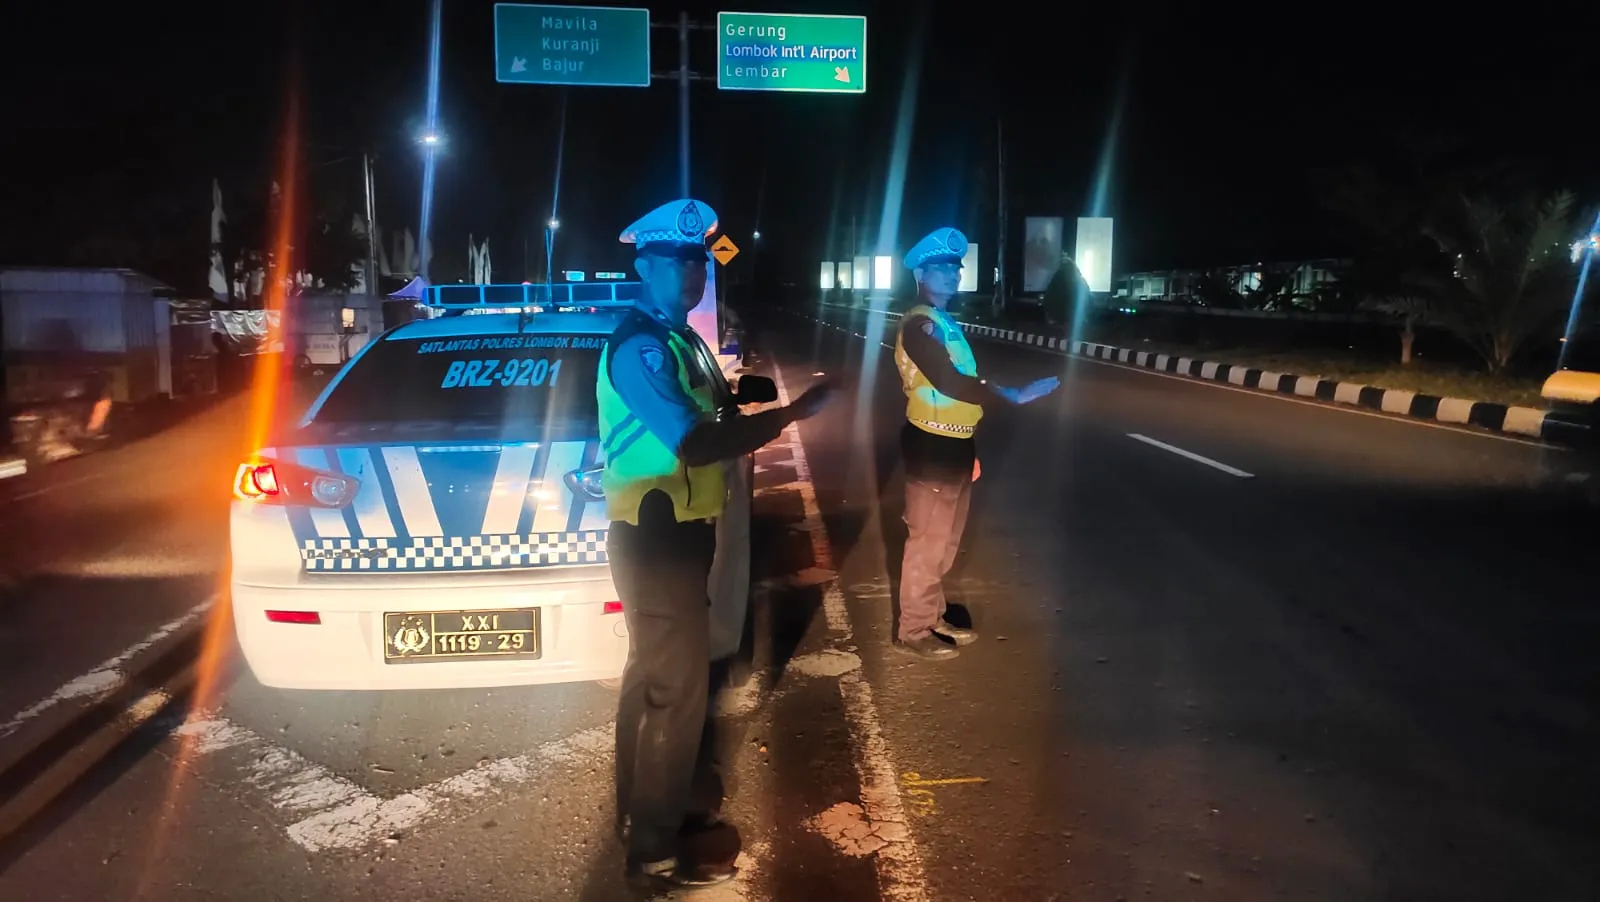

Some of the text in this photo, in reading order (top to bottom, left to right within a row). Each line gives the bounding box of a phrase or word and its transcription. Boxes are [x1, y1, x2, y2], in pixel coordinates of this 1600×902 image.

[542, 16, 597, 31] Mavila
[726, 23, 786, 41] Gerung
[542, 37, 599, 55] Kuranji
[726, 44, 857, 62] Lombok Int'l Airport
[542, 58, 584, 75] Bajur
[726, 65, 788, 78] Lembar
[417, 337, 608, 353] SATLANTAS POLRES LOMBOK BARAT
[441, 358, 562, 389] BRZ-9201
[461, 614, 499, 632] XXI
[438, 635, 481, 652] 1119
[497, 633, 525, 650] 29
